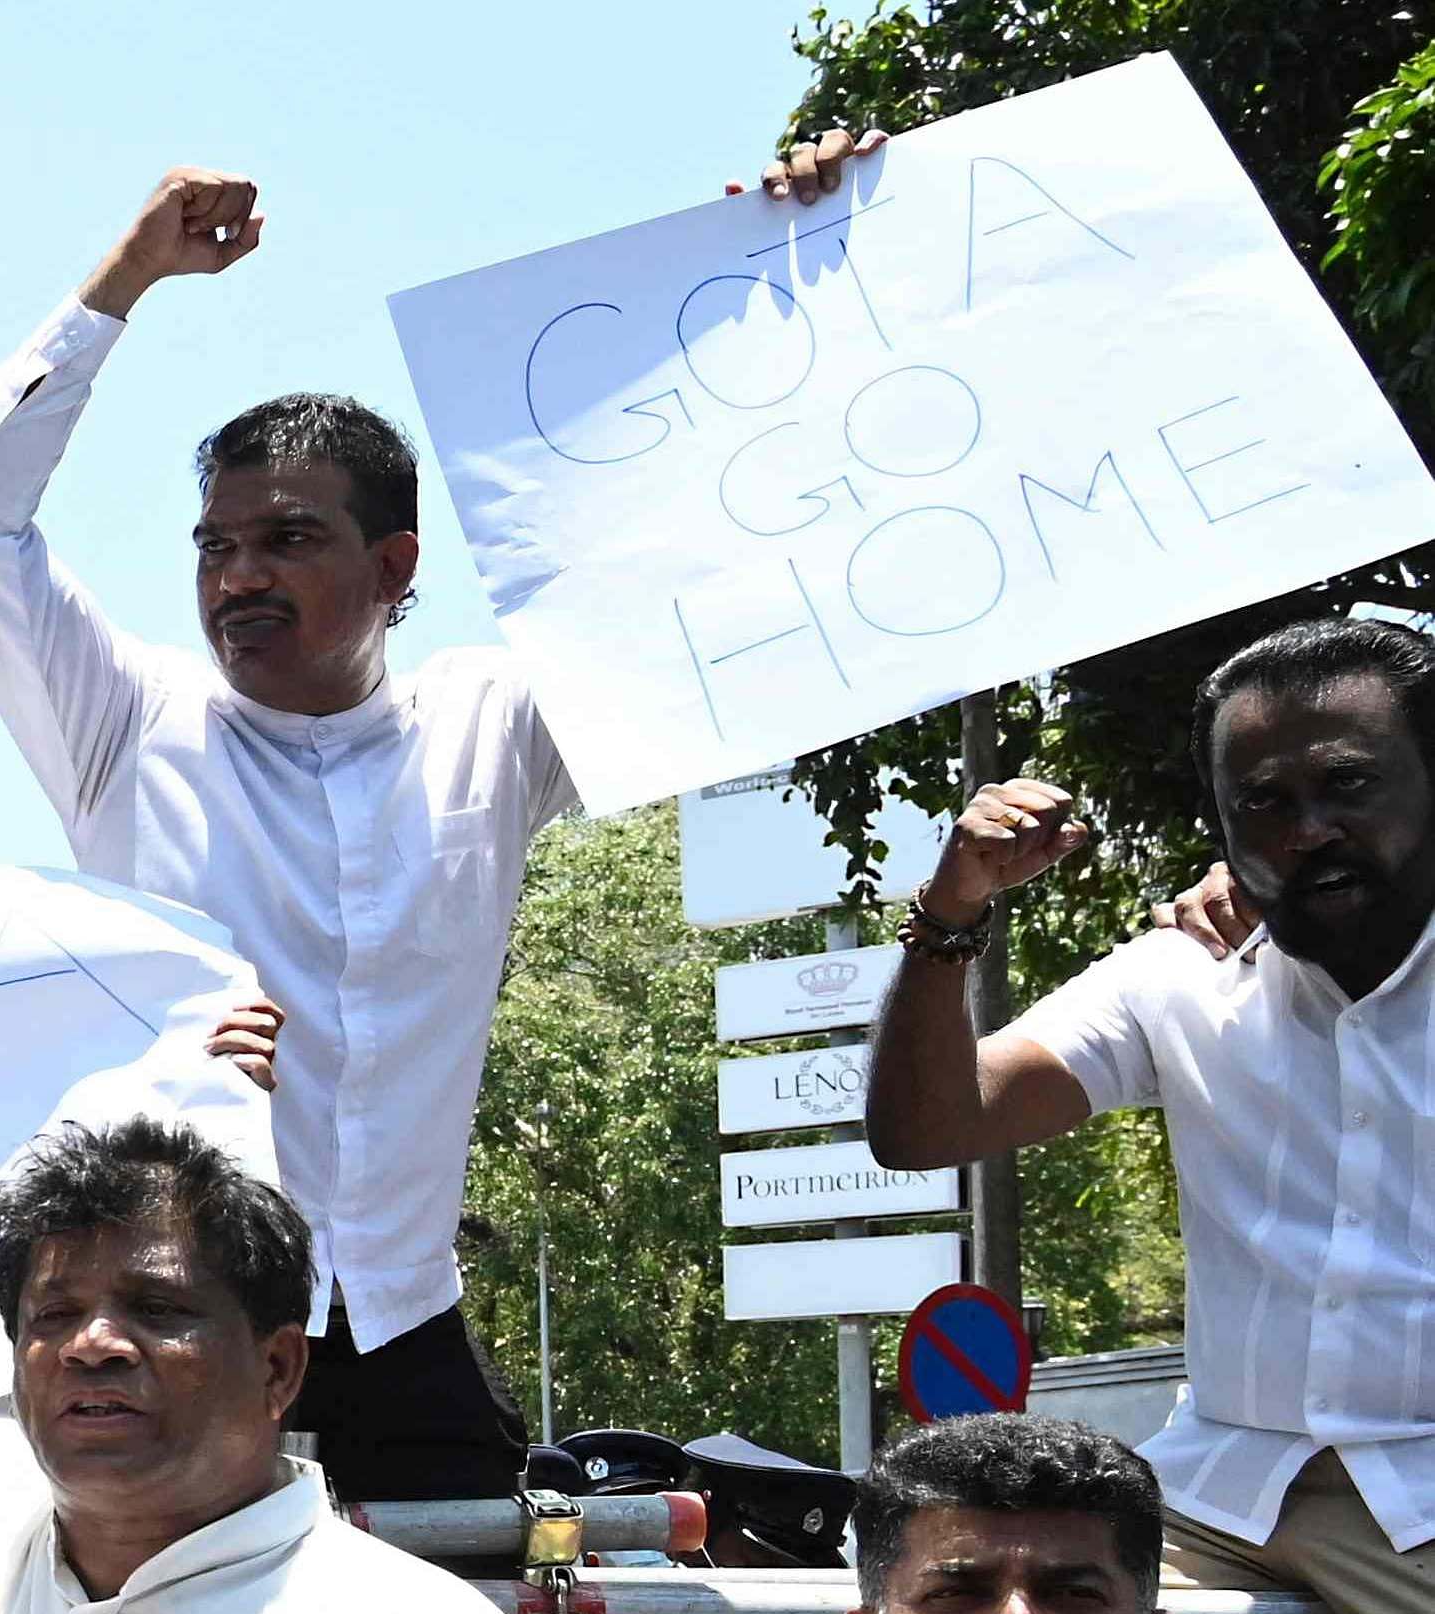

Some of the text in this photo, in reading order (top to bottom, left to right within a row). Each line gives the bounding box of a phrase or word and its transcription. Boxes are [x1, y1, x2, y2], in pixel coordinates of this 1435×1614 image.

[717, 364, 982, 536] GO
[673, 395, 1312, 743] HOME
[774, 1066, 863, 1101] LENO
